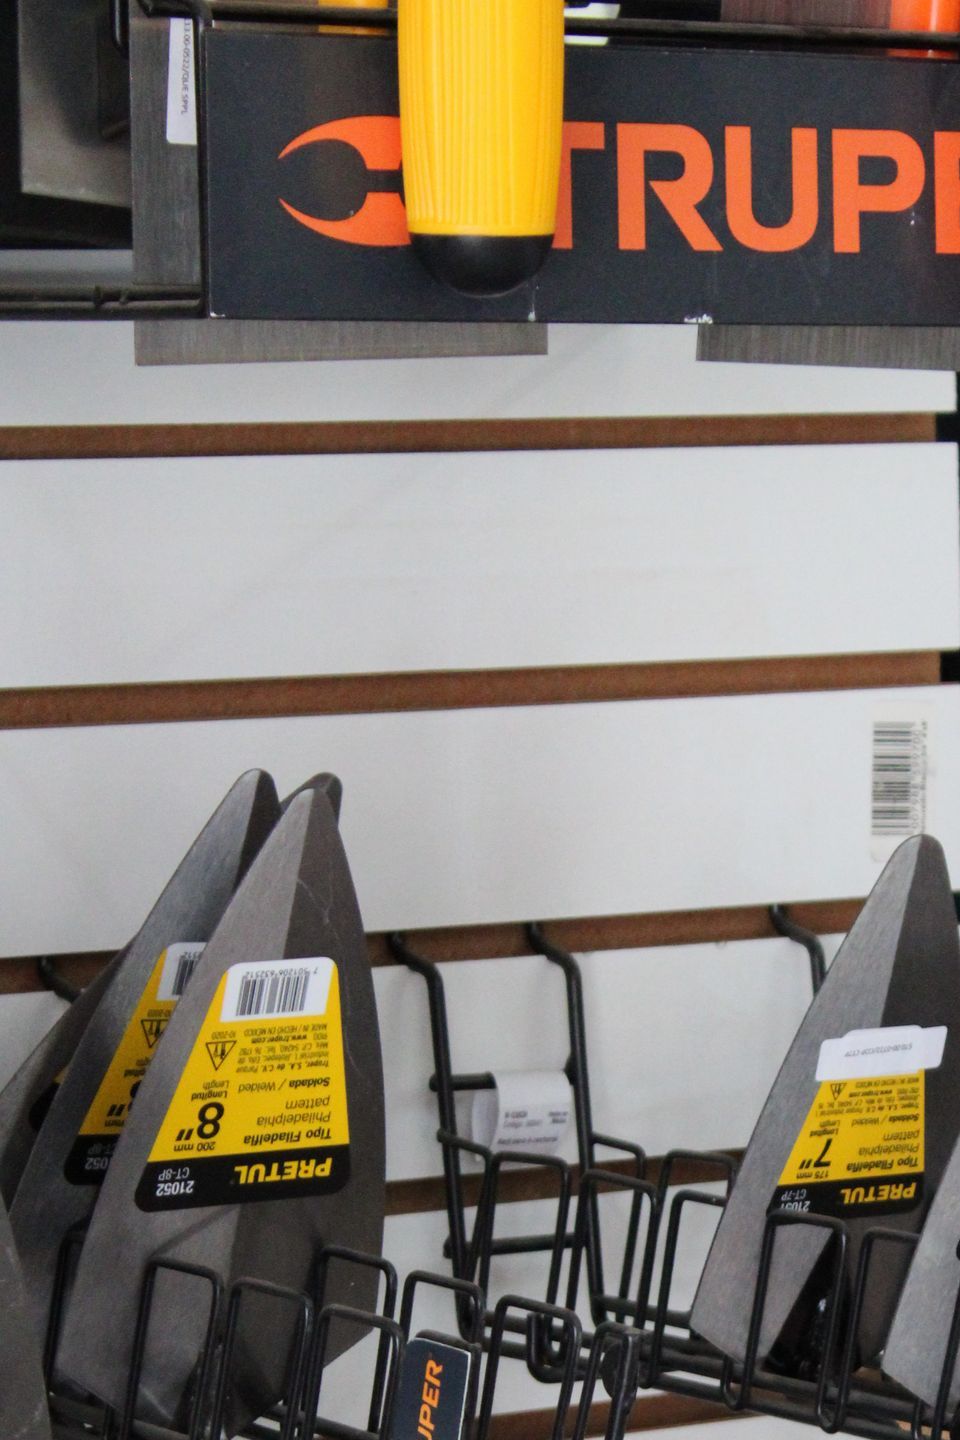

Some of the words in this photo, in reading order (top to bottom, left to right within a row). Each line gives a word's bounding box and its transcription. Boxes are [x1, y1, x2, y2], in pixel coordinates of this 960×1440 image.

[202, 1079, 229, 1090] Length
[237, 1081, 276, 1093] Welded
[288, 1076, 330, 1088] Soldada
[190, 1089, 227, 1100] Longitud
[285, 1094, 330, 1109] pattern
[256, 1110, 330, 1126] Philadelphia
[243, 1130, 301, 1144] Filadelfia
[305, 1126, 331, 1138] Tipo
[882, 1129, 919, 1141] pattern
[173, 1143, 193, 1152] mm
[196, 1141, 215, 1150] 200
[858, 1142, 919, 1156] Philadelphia
[846, 1159, 894, 1171] Filadelfia
[896, 1156, 919, 1166] Tipo
[157, 1166, 189, 1180] CT-8P
[233, 1156, 332, 1184] PRETUL
[795, 1171, 813, 1179] mm
[814, 1170, 829, 1178] 175
[155, 1179, 194, 1195] 21052
[839, 1181, 916, 1203] PRETUL
[780, 1188, 806, 1200] CT-7P
[780, 1200, 810, 1214] 21051
